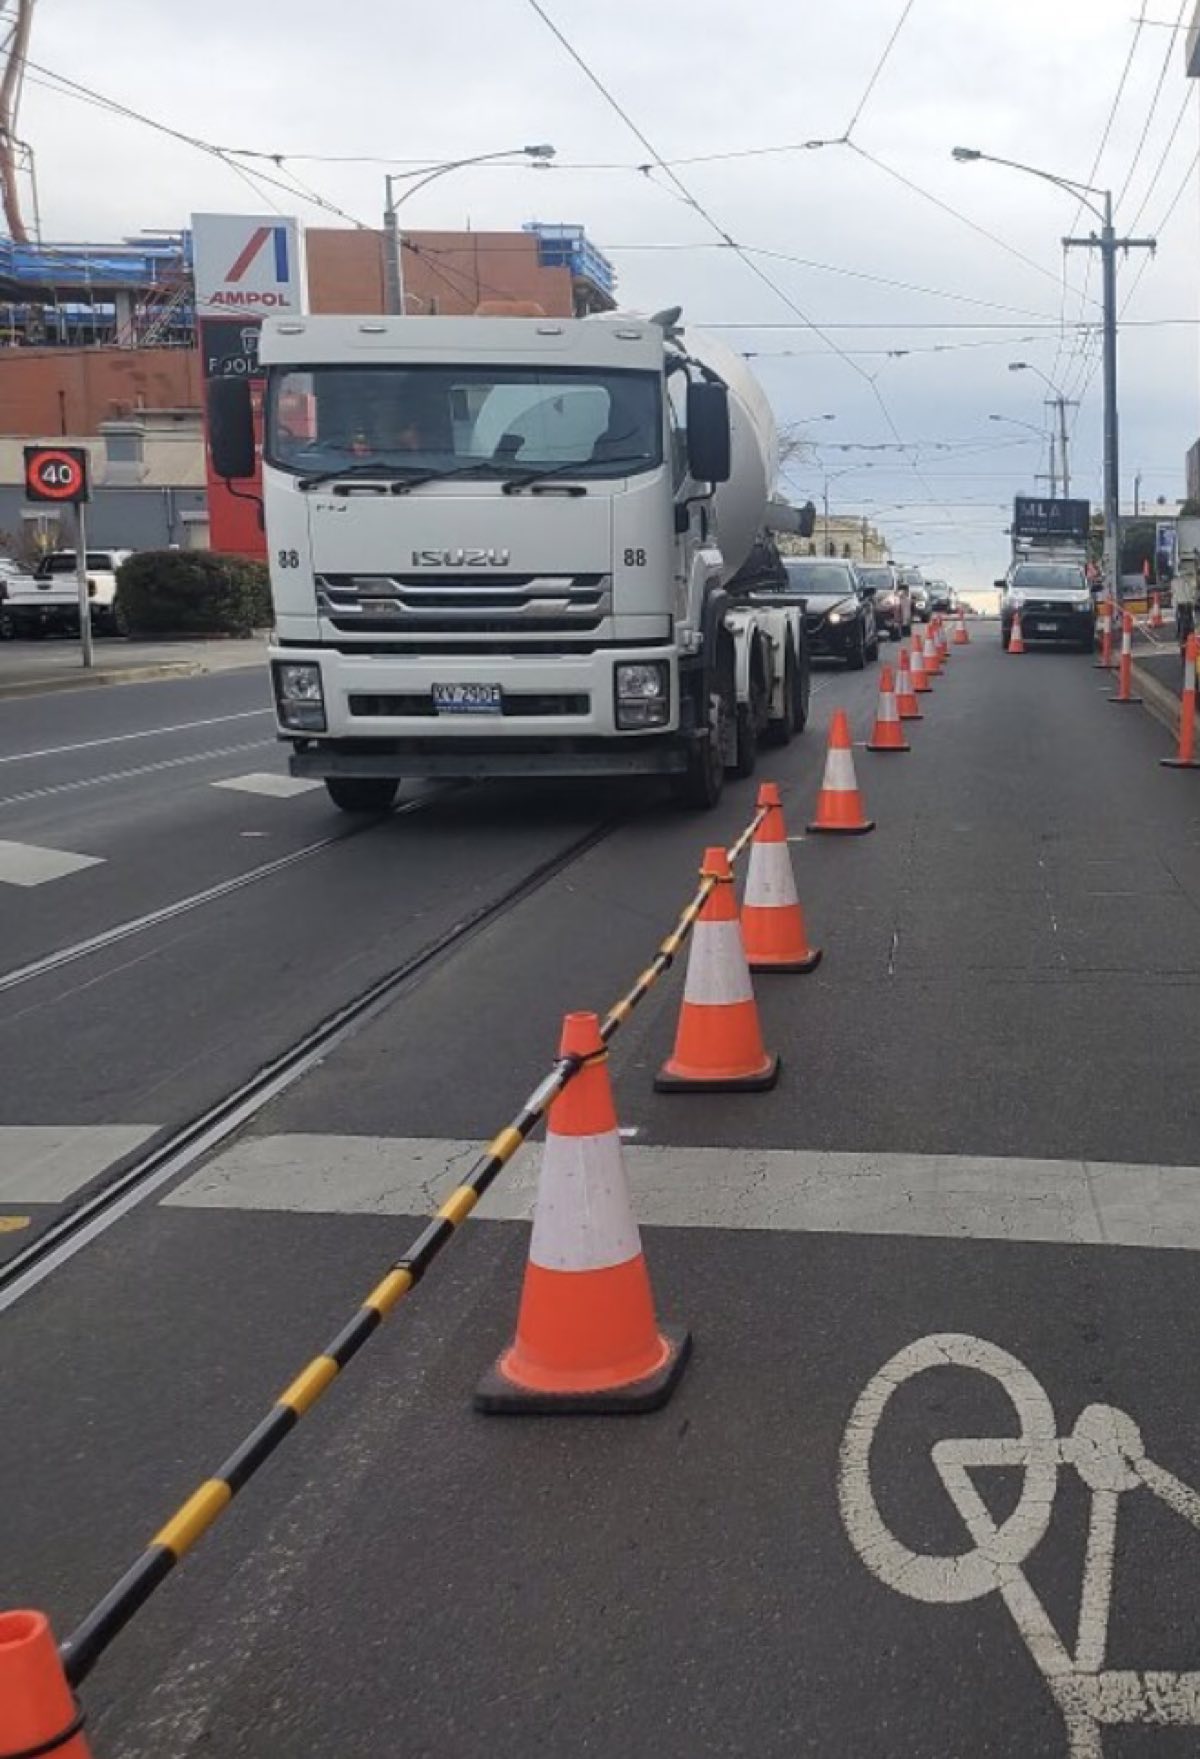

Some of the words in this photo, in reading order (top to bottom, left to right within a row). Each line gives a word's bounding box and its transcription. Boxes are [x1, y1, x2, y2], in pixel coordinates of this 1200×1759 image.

[208, 291, 291, 307] AMPOL
[42, 465, 72, 484] 40
[278, 550, 300, 568] 88
[411, 550, 510, 567] ISUZU
[623, 549, 647, 566] 88
